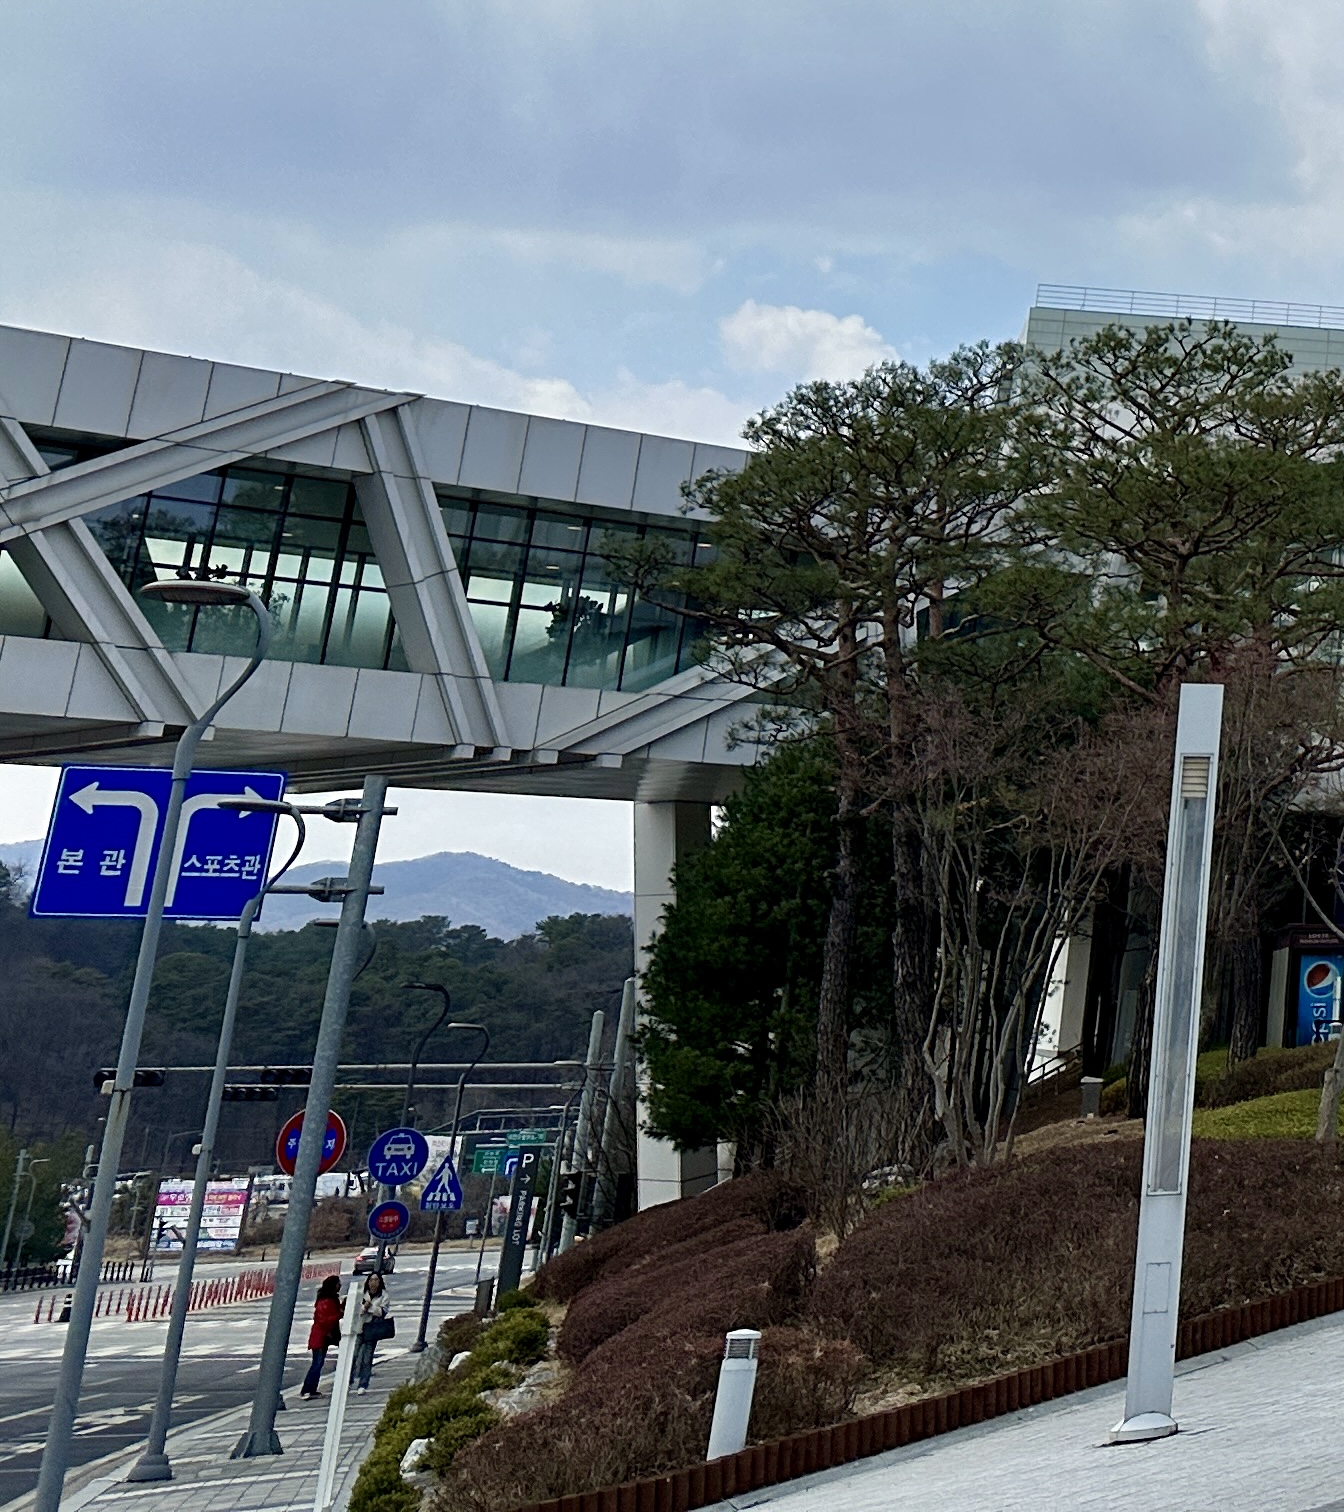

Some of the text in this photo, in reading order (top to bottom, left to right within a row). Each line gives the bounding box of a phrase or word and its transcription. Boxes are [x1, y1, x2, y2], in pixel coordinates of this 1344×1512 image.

[181, 854, 261, 880] 스포츠관
[521, 1153, 534, 1168] P
[375, 1161, 418, 1178] TAXI
